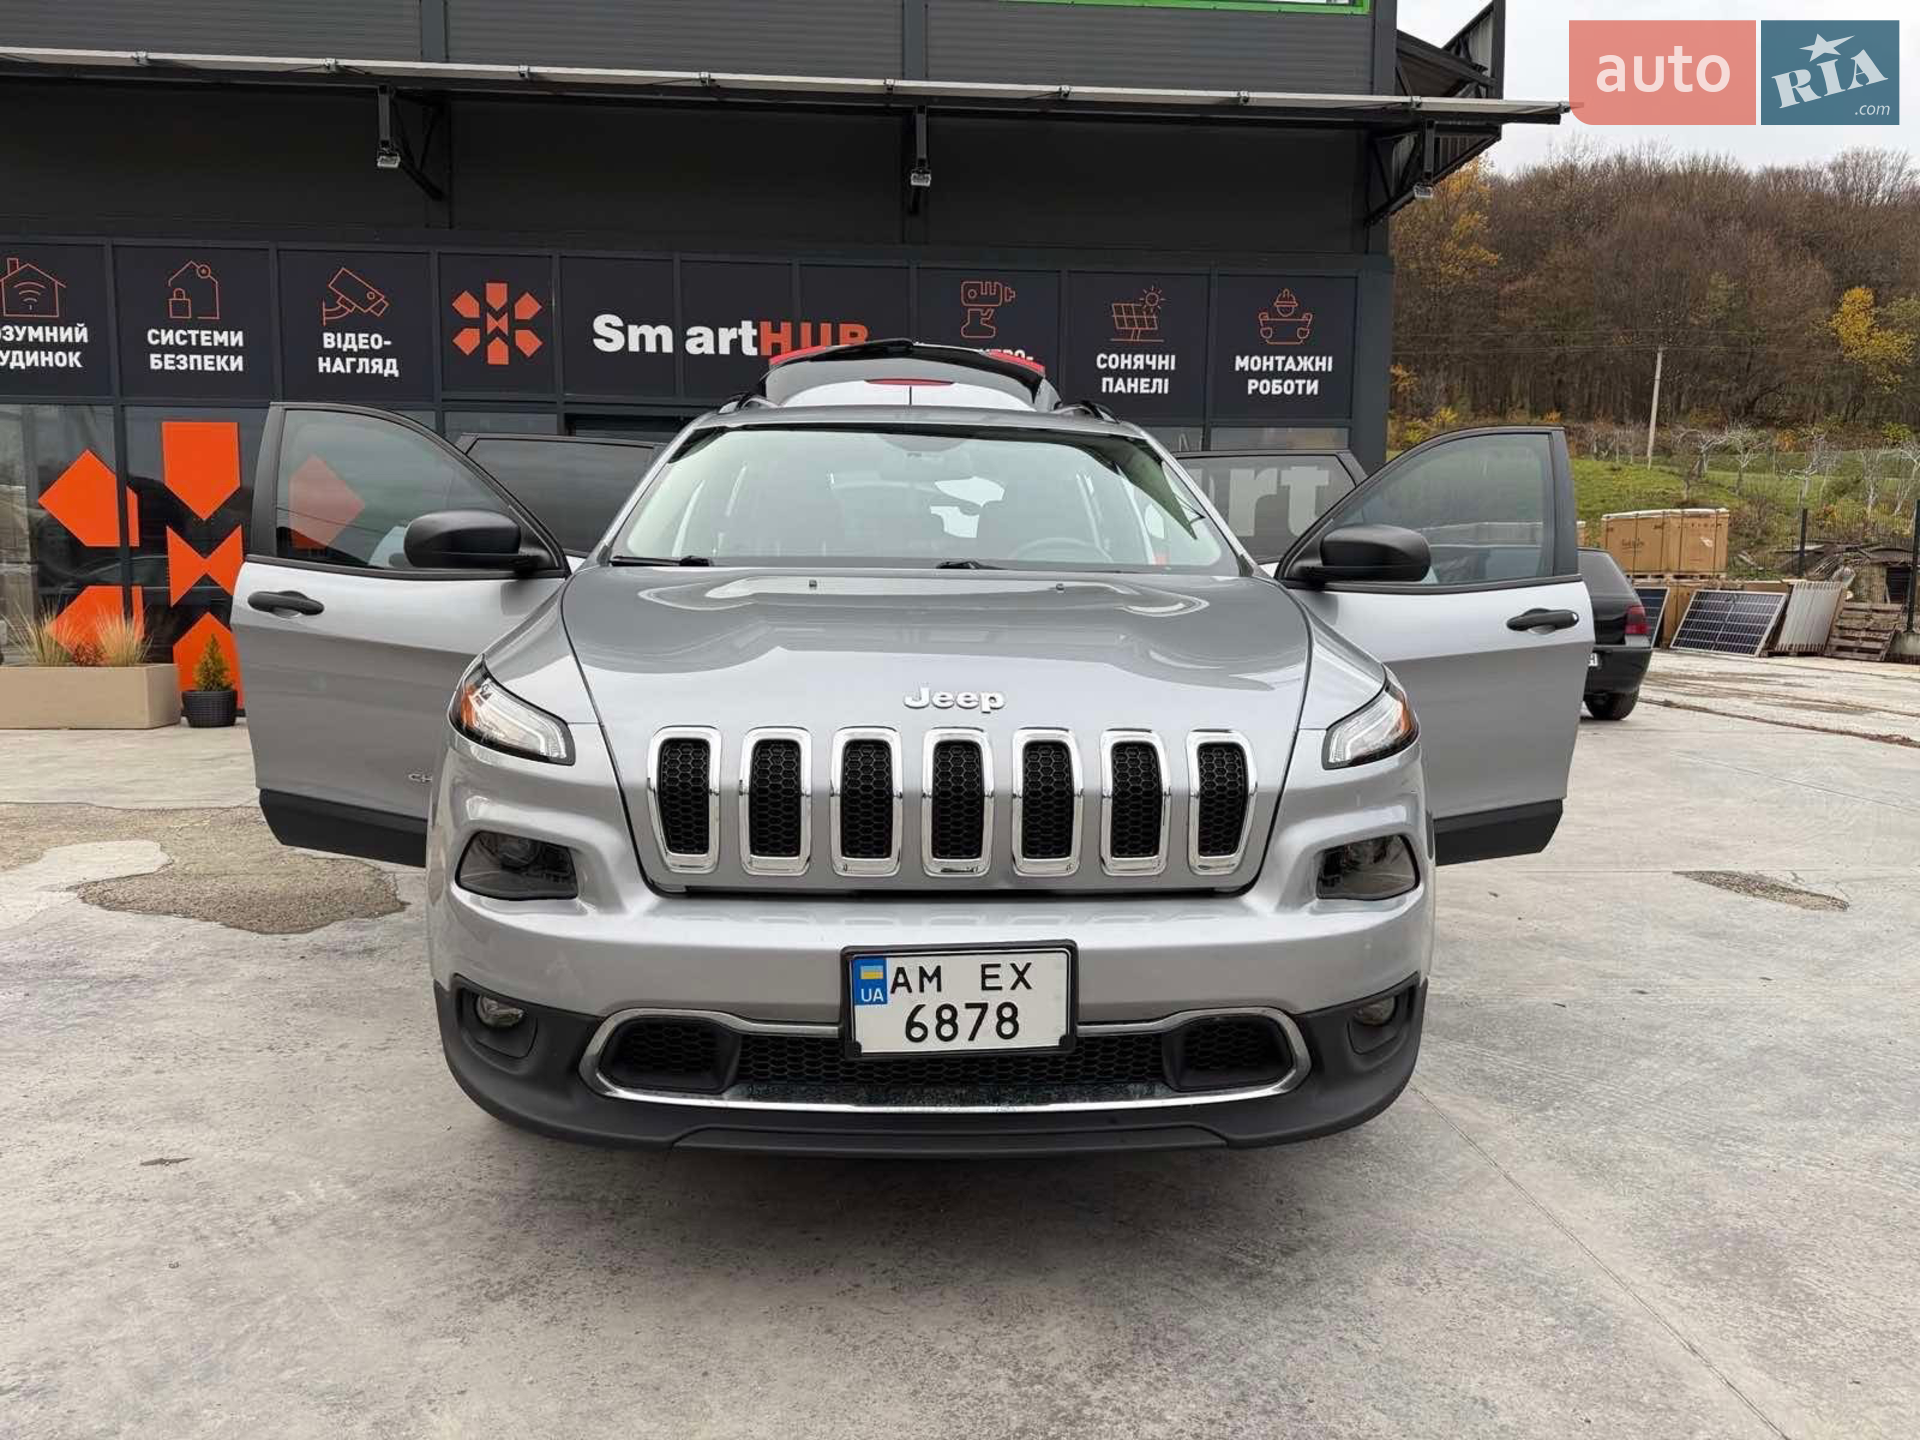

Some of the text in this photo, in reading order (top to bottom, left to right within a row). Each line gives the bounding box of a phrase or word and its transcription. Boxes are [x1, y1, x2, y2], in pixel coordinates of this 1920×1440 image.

[0, 323, 88, 343] ЗУМНИЙ
[147, 328, 244, 347] СИСТЕМИ
[322, 332, 392, 352] ВІДЕО-
[149, 353, 244, 372] БЕЗПЕКИ
[318, 356, 399, 377] НАГЛЯД
[1096, 353, 1176, 370] СОНЯЧНІ
[1234, 355, 1333, 372] МОНТАЖНІ
[1101, 377, 1169, 394] ПАНЕЛІ
[1247, 379, 1319, 395] РОБОТИ
[903, 686, 1005, 714] Jeep
[890, 962, 1033, 994] AM EX
[861, 988, 884, 1002] UA
[905, 1002, 1020, 1043] 6878
